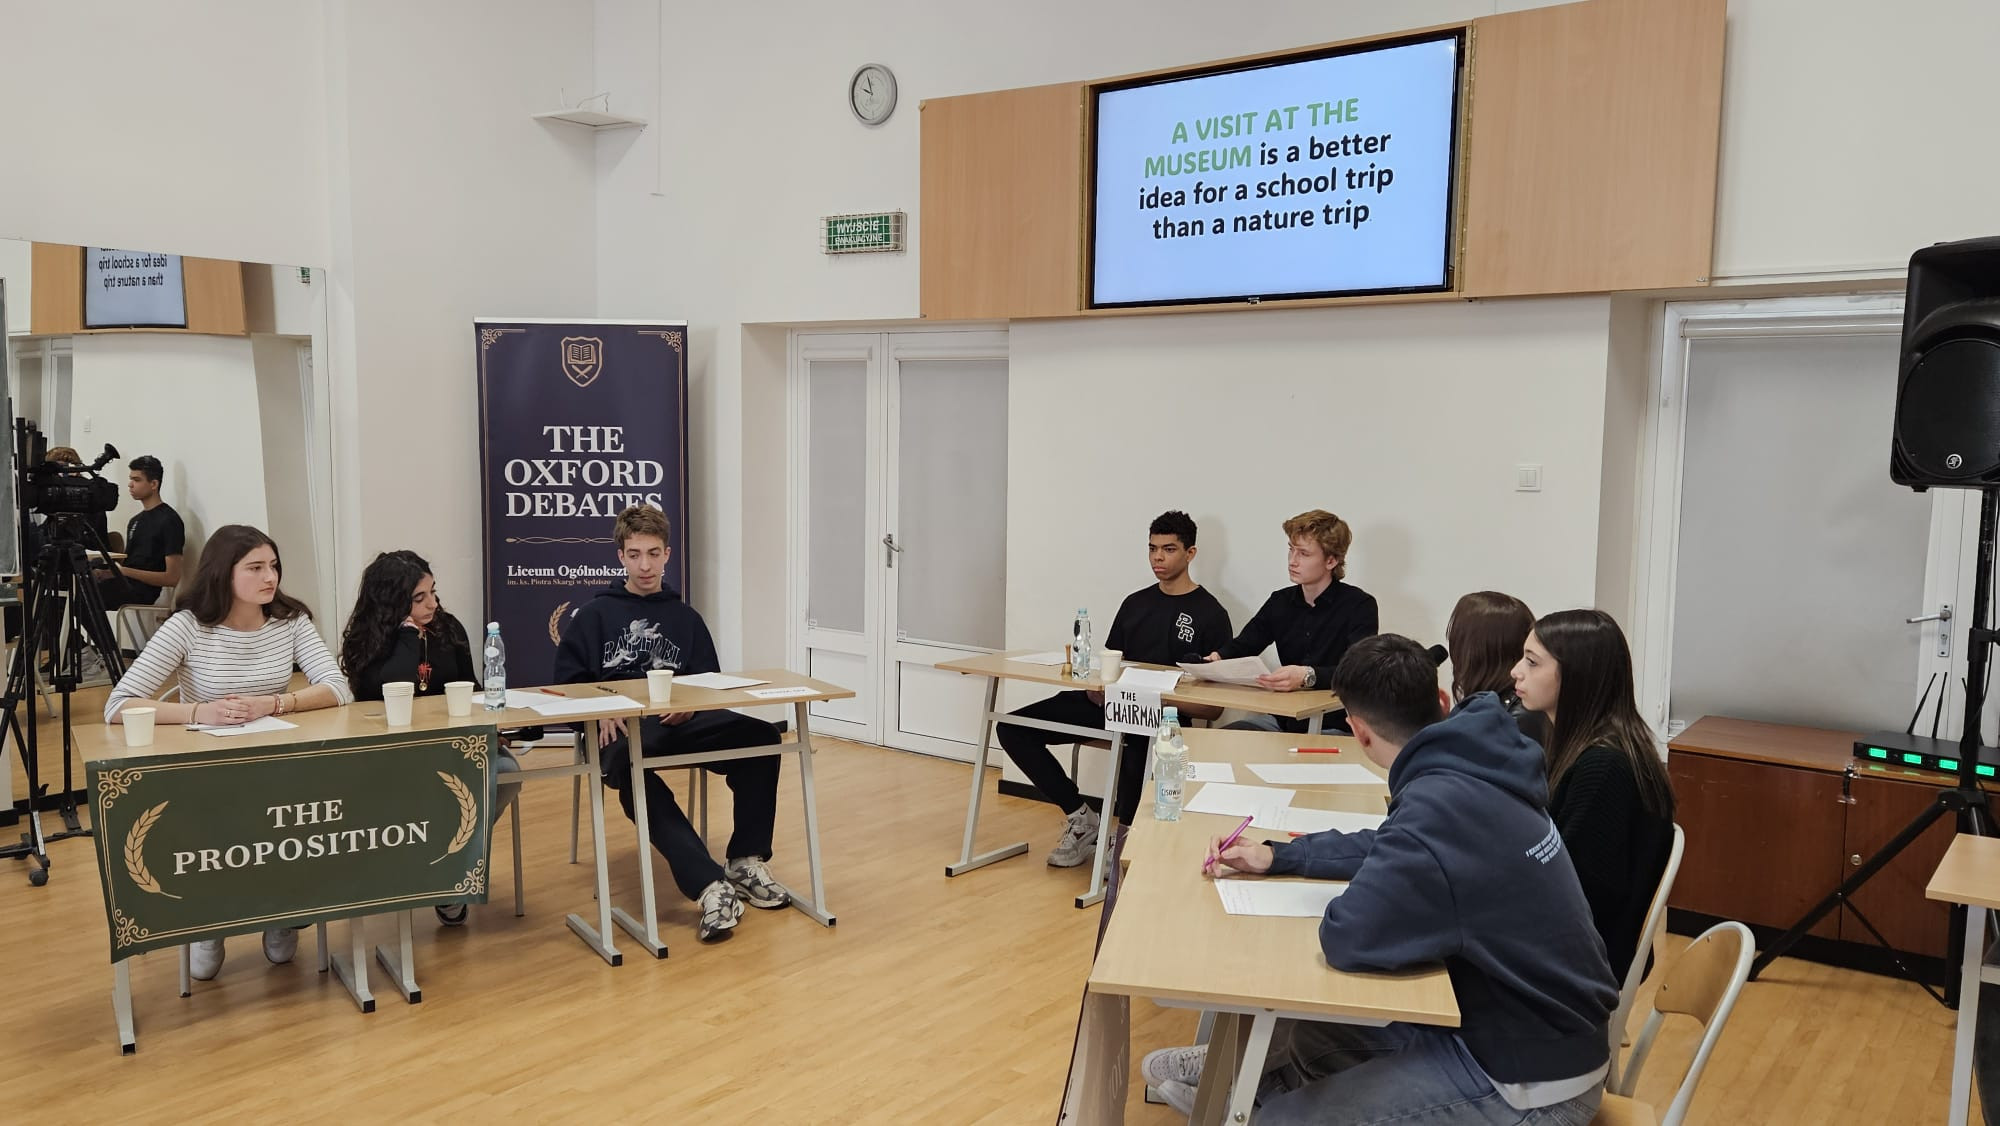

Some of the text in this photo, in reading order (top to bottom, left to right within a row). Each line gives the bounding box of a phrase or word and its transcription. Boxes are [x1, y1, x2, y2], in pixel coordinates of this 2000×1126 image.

[1172, 98, 1359, 144] A VISIT AT THE
[1145, 133, 1392, 178] MUSEUM is a better
[1139, 163, 1394, 210] idea for a school trip
[1153, 216, 1204, 240] than
[1212, 217, 1225, 235] a
[1233, 209, 1315, 233] nature
[542, 426, 624, 453] THE
[504, 458, 664, 487] OXFORD
[507, 564, 628, 580] Liceum Ogólnokszt
[1120, 691, 1136, 701] THE
[1105, 701, 1161, 729] CHAIRMAN
[266, 799, 343, 829] THE
[173, 821, 430, 875] PROPOSITION
